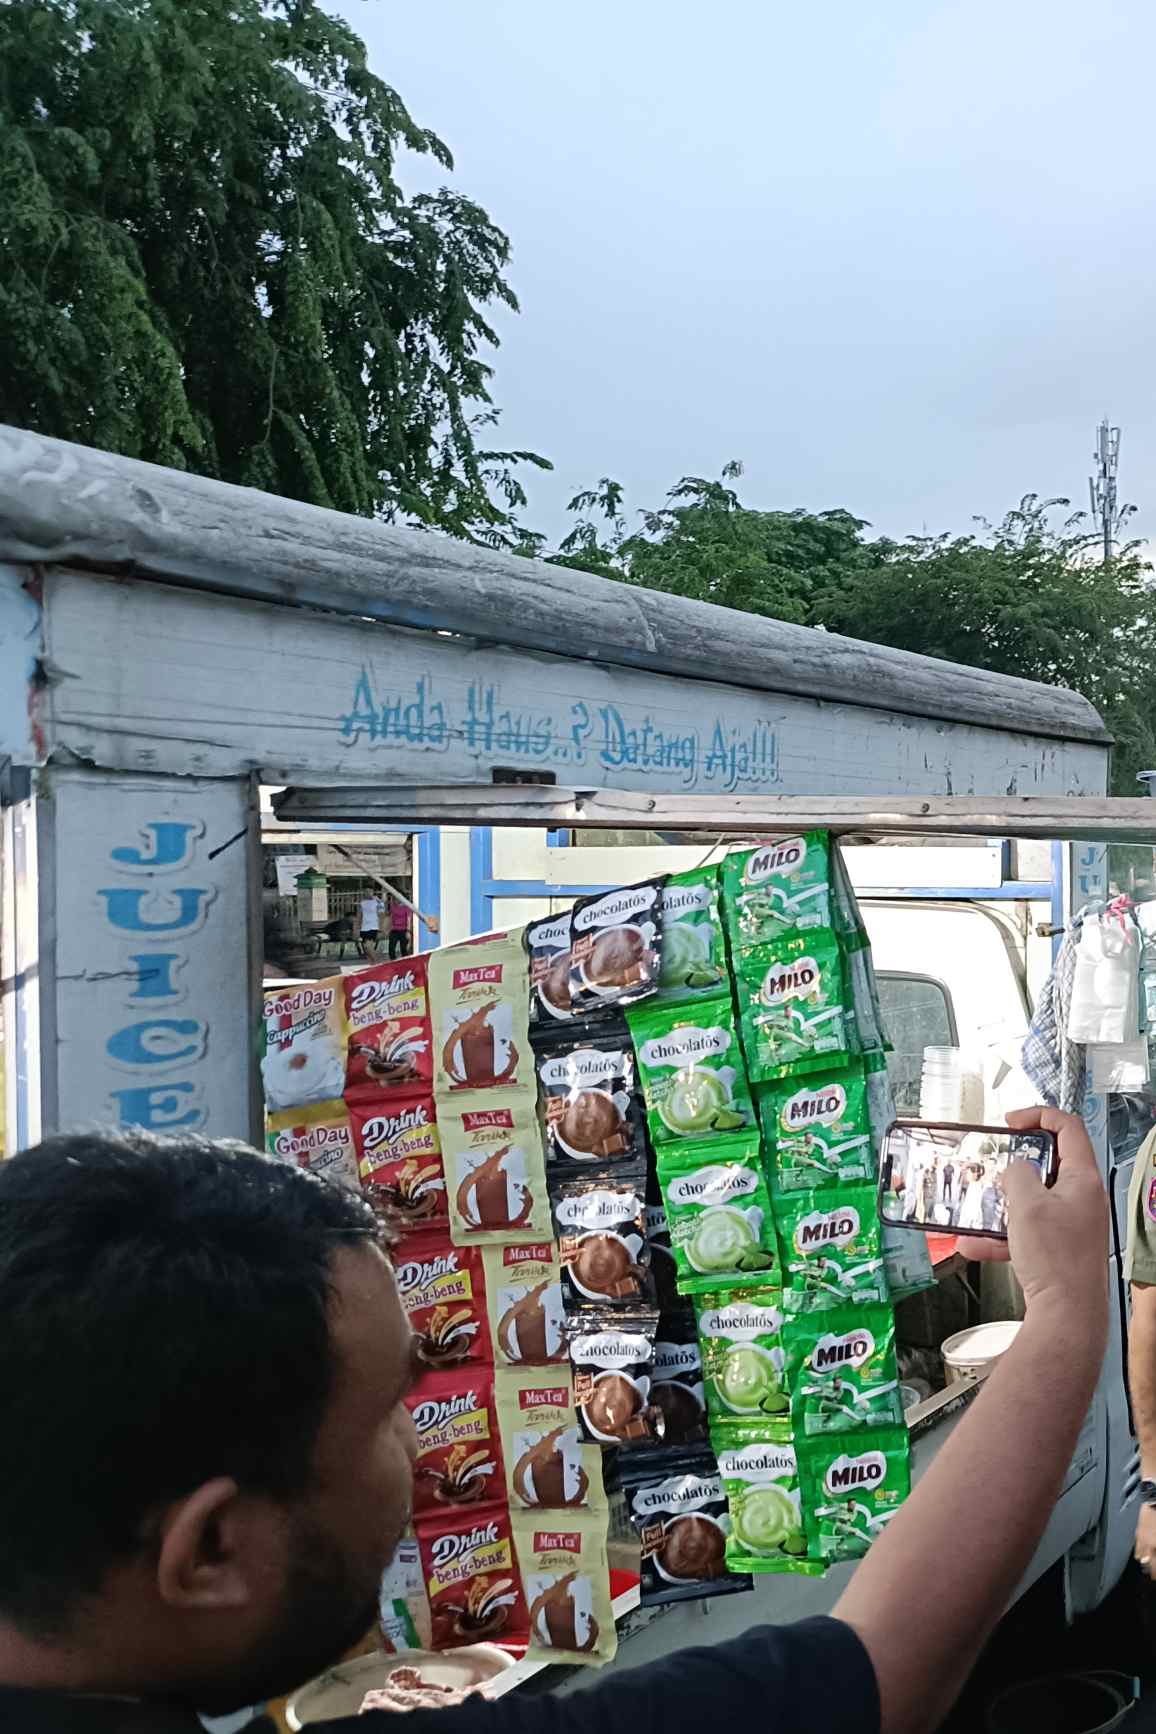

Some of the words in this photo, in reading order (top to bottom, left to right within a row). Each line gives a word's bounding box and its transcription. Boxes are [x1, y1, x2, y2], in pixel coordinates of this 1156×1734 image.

[340, 666, 446, 744] Anda
[600, 703, 697, 785] Datang
[751, 848, 800, 874] MILO
[97, 821, 208, 1129] JUICE
[352, 970, 416, 1009] Drink
[770, 968, 814, 994] MILO
[352, 998, 420, 1026] beng-beng
[790, 1097, 840, 1120] MILO
[361, 1105, 430, 1147] Drink
[366, 1134, 434, 1165] beng-beng
[801, 1219, 854, 1244] MILO
[399, 1252, 459, 1293] Drink
[816, 1340, 867, 1367] MILO
[412, 1390, 478, 1432] Drink
[831, 1464, 882, 1488] MILO
[431, 1521, 499, 1567] Drink
[435, 1550, 506, 1584] beng-beng
